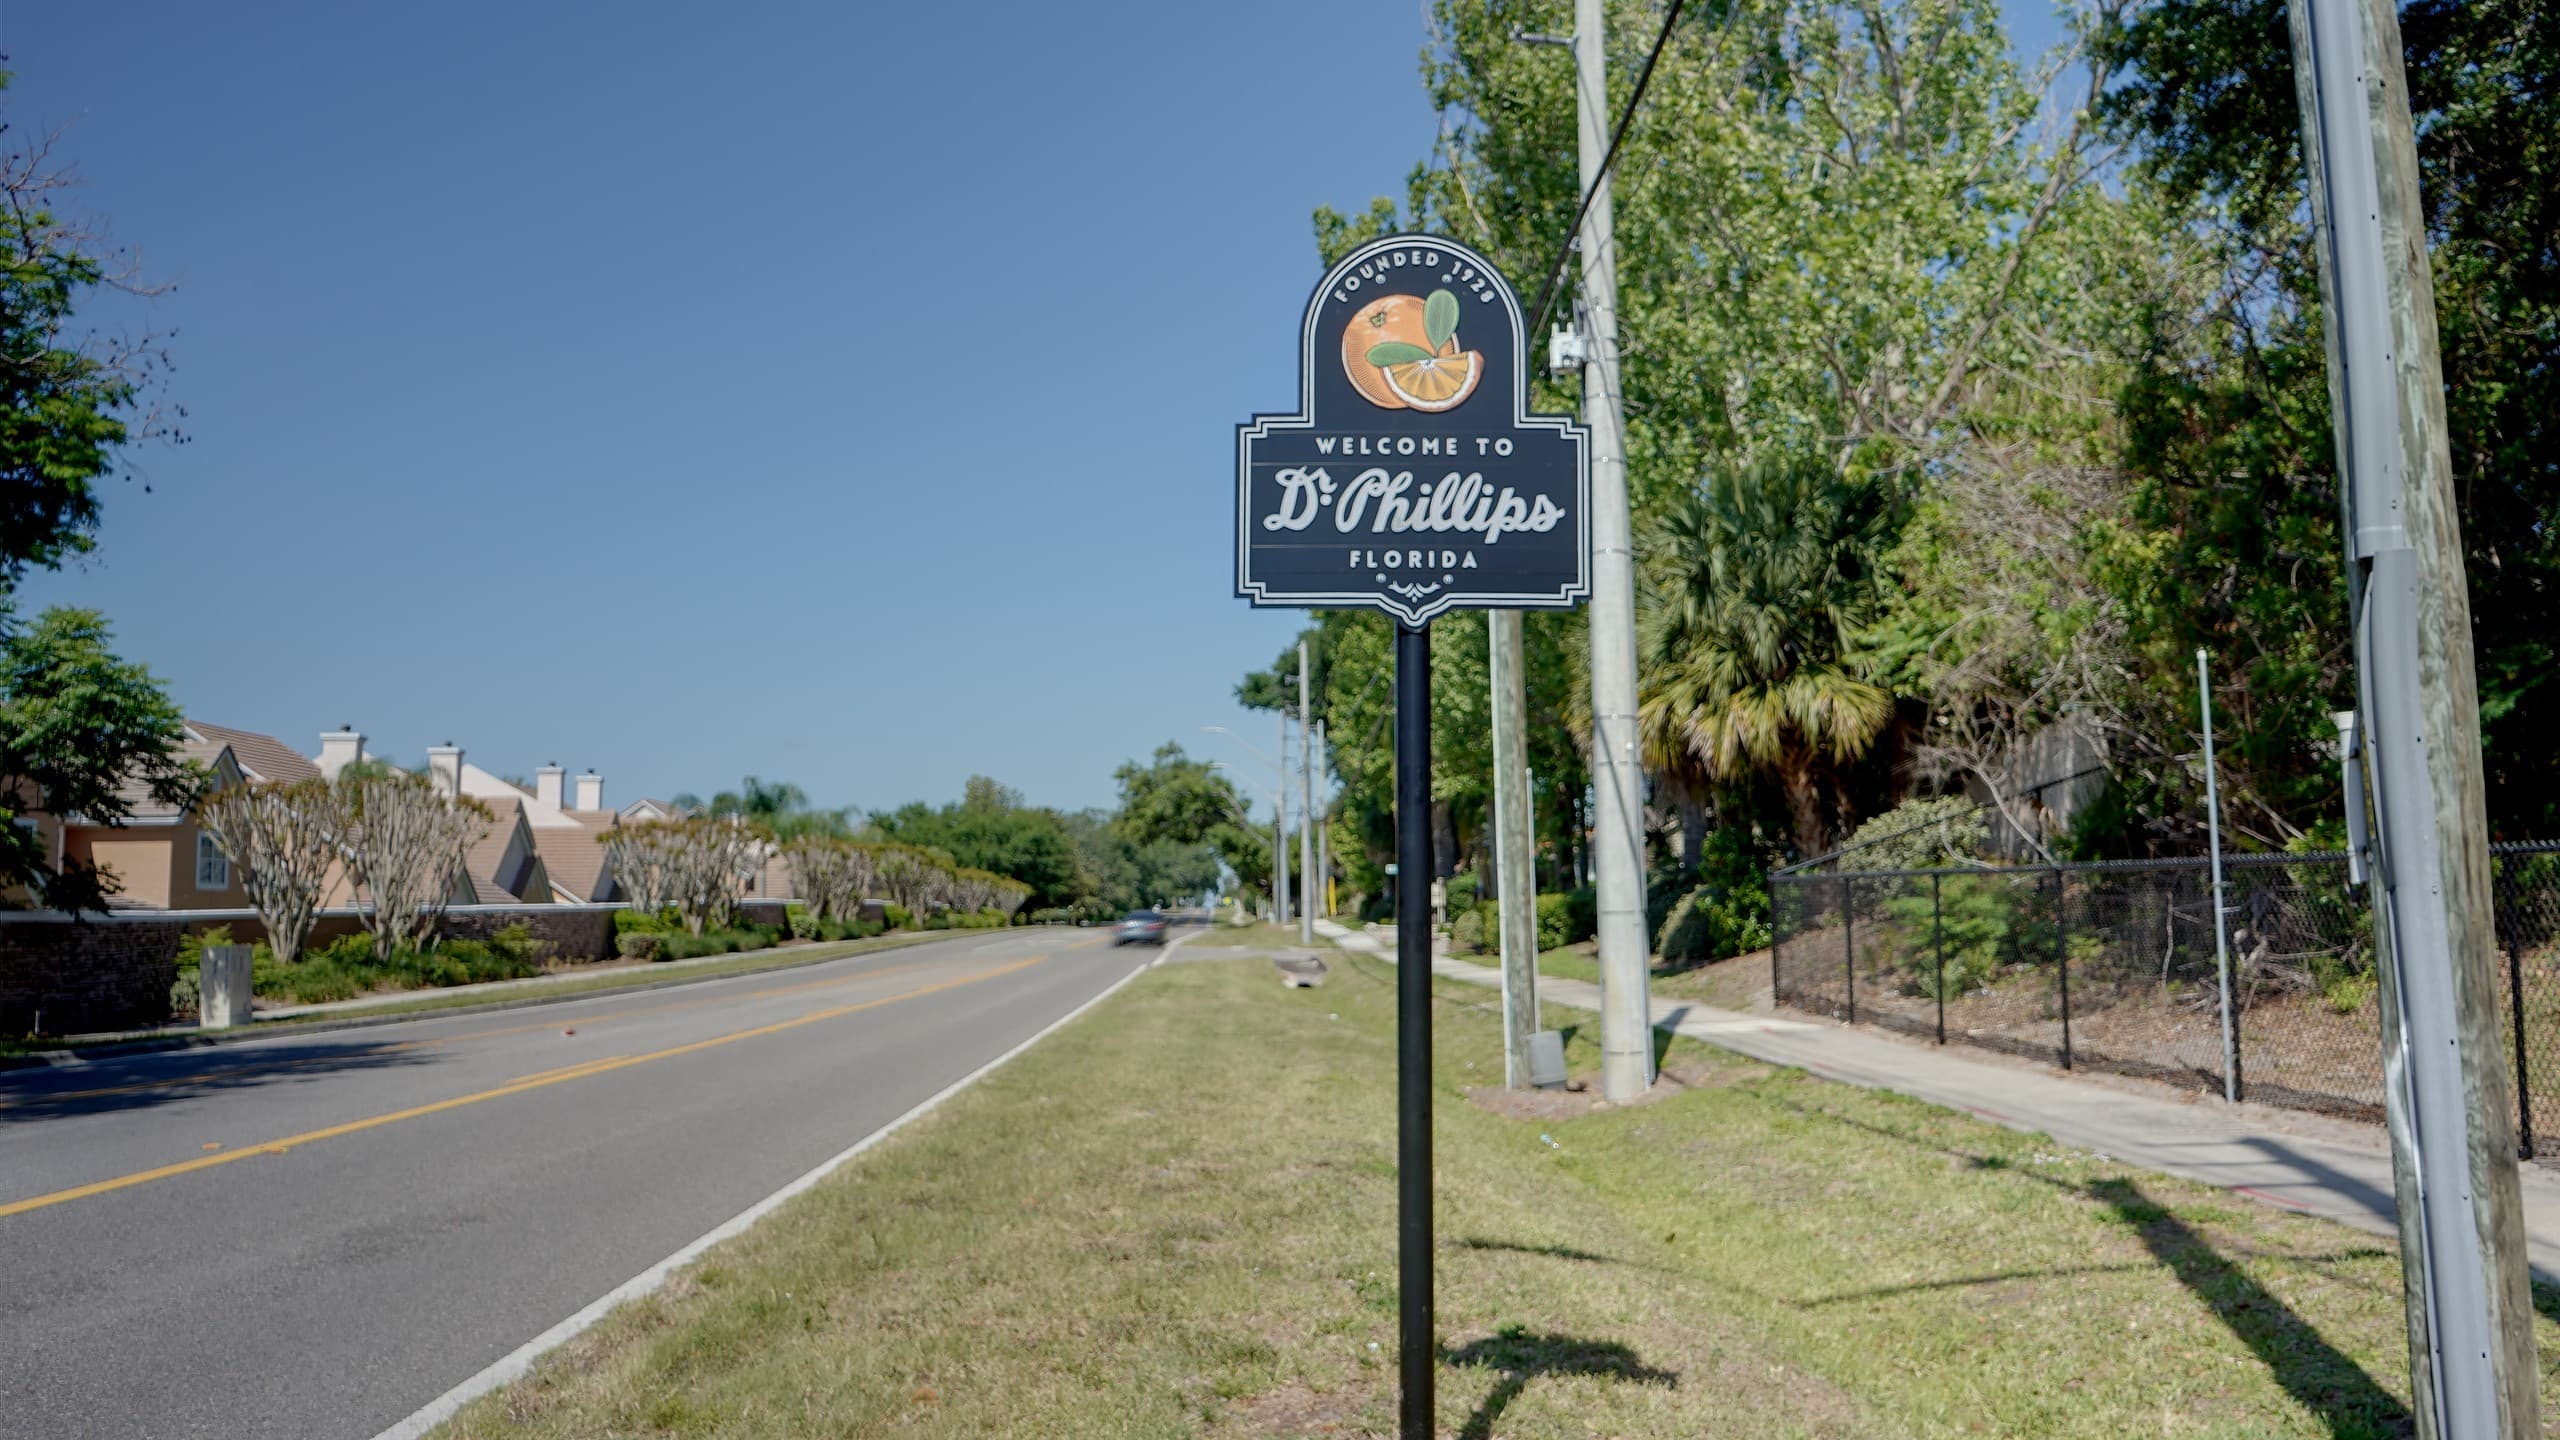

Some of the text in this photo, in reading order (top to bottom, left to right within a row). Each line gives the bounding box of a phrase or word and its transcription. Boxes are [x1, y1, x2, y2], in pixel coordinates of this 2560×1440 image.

[1334, 251, 1496, 304] FOUNDED 1928
[1315, 436, 1514, 456] WELCOME TO
[1335, 467, 1566, 544] Phillips
[1350, 550, 1478, 569] FLORIDA
